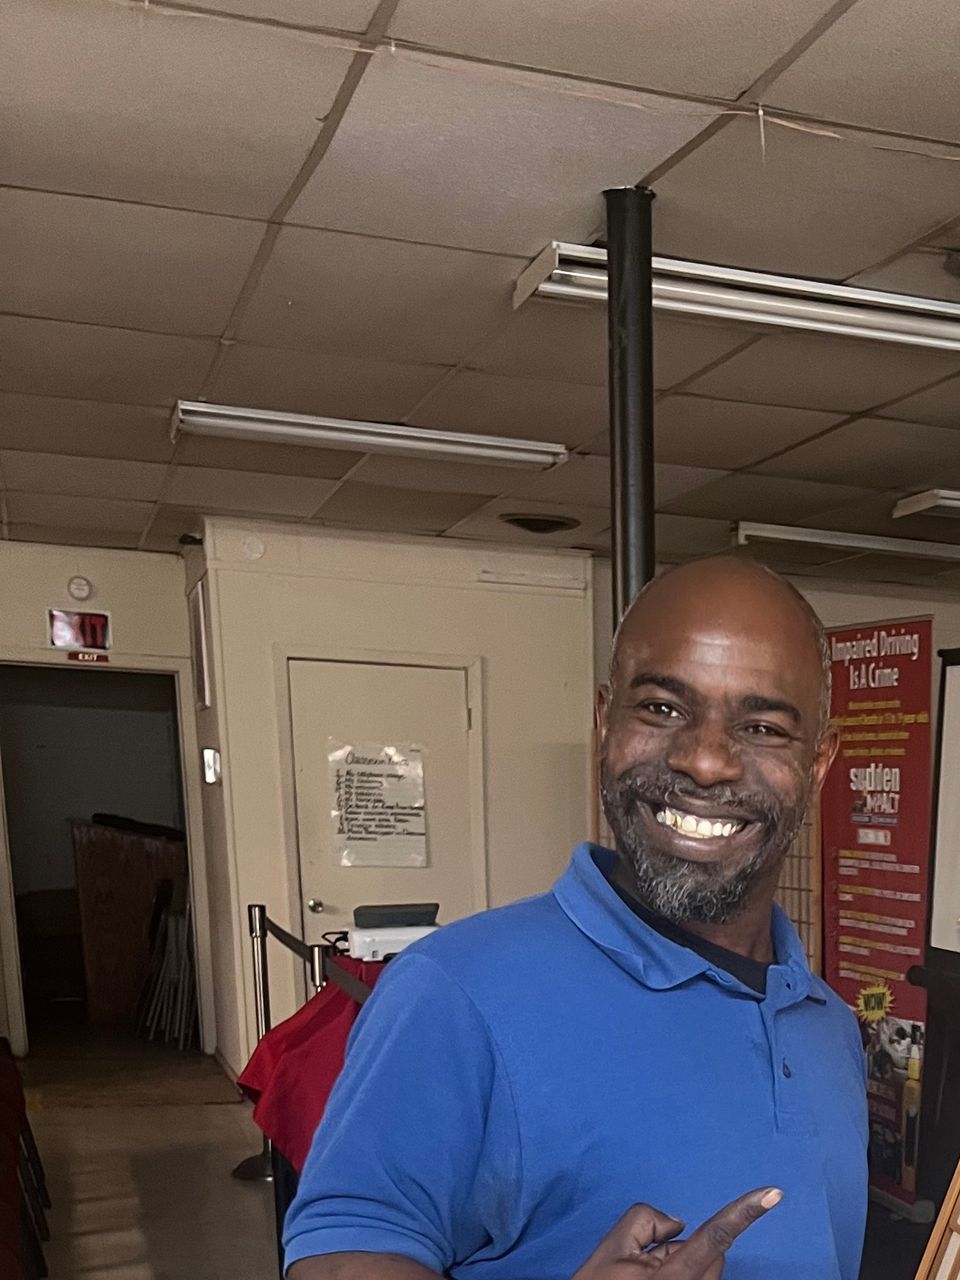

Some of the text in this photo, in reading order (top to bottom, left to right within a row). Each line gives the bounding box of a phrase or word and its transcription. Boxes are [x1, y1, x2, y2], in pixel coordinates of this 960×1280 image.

[78, 652, 98, 661] EXIT
[832, 628, 919, 667] Impaired Driving
[850, 662, 899, 689] Is A Crime
[850, 763, 900, 792] sudden
